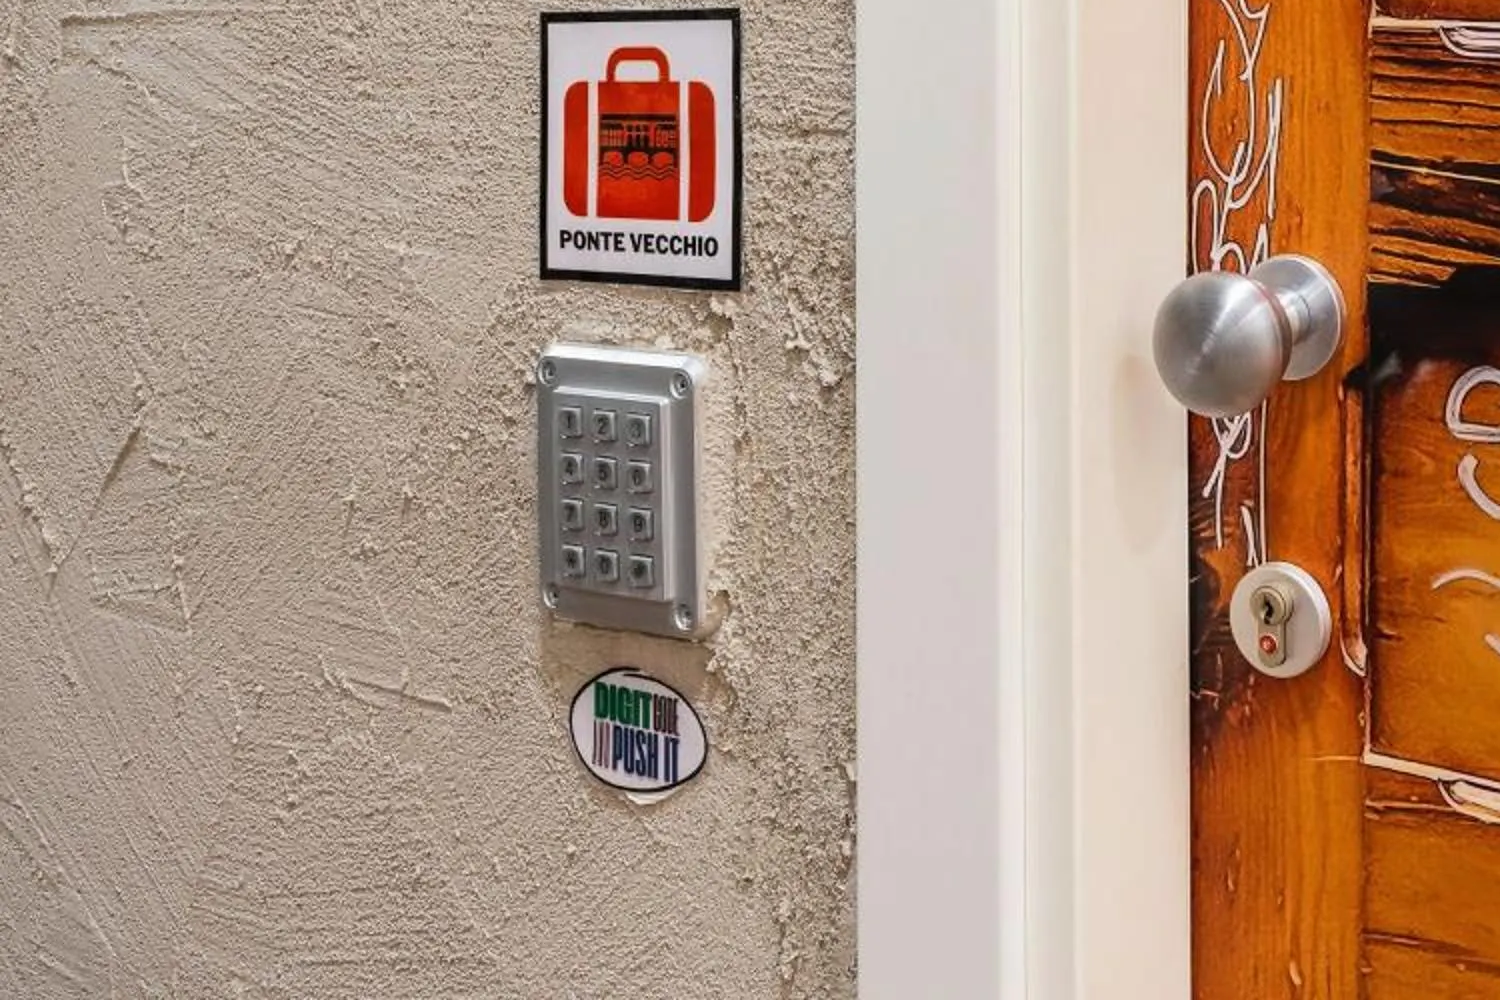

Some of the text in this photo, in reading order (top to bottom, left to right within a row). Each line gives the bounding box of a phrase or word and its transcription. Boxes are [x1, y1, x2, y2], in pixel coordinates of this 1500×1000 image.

[559, 229, 720, 258] PONTE VECCHIO
[593, 681, 653, 730] DIGIT
[612, 724, 659, 781] PUSH
[663, 734, 680, 785] IT
